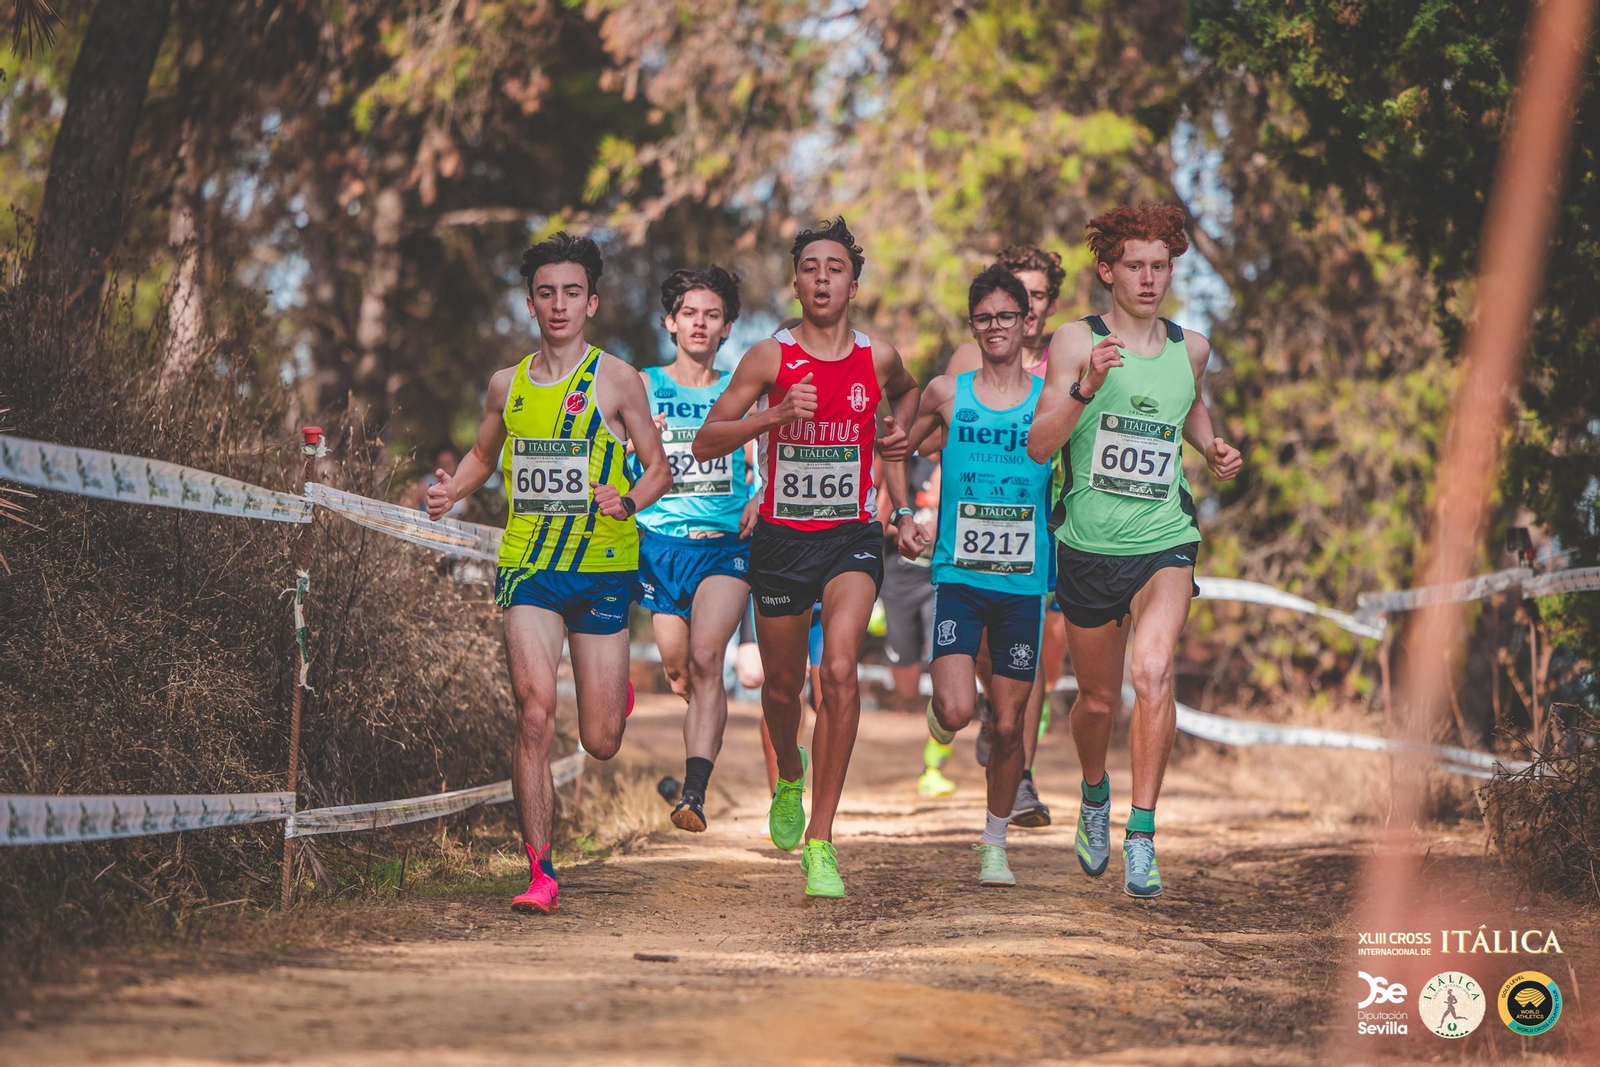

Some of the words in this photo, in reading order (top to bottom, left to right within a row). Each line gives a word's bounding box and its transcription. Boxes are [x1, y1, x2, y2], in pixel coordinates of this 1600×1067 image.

[778, 418, 860, 444] CURTIUS
[1123, 419, 1161, 434] ITÁLICA
[528, 441, 567, 452] ITÁLICA
[799, 447, 840, 458] ITÁLICA
[667, 453, 728, 476] 8204
[968, 452, 1024, 465] ATLETISMO
[1101, 444, 1172, 477] 6057
[517, 467, 583, 494] 6058
[782, 473, 854, 499] 8166
[980, 506, 1017, 517] ITÁLICA
[963, 530, 1030, 556] 8217
[761, 595, 791, 606] CURTIUS
